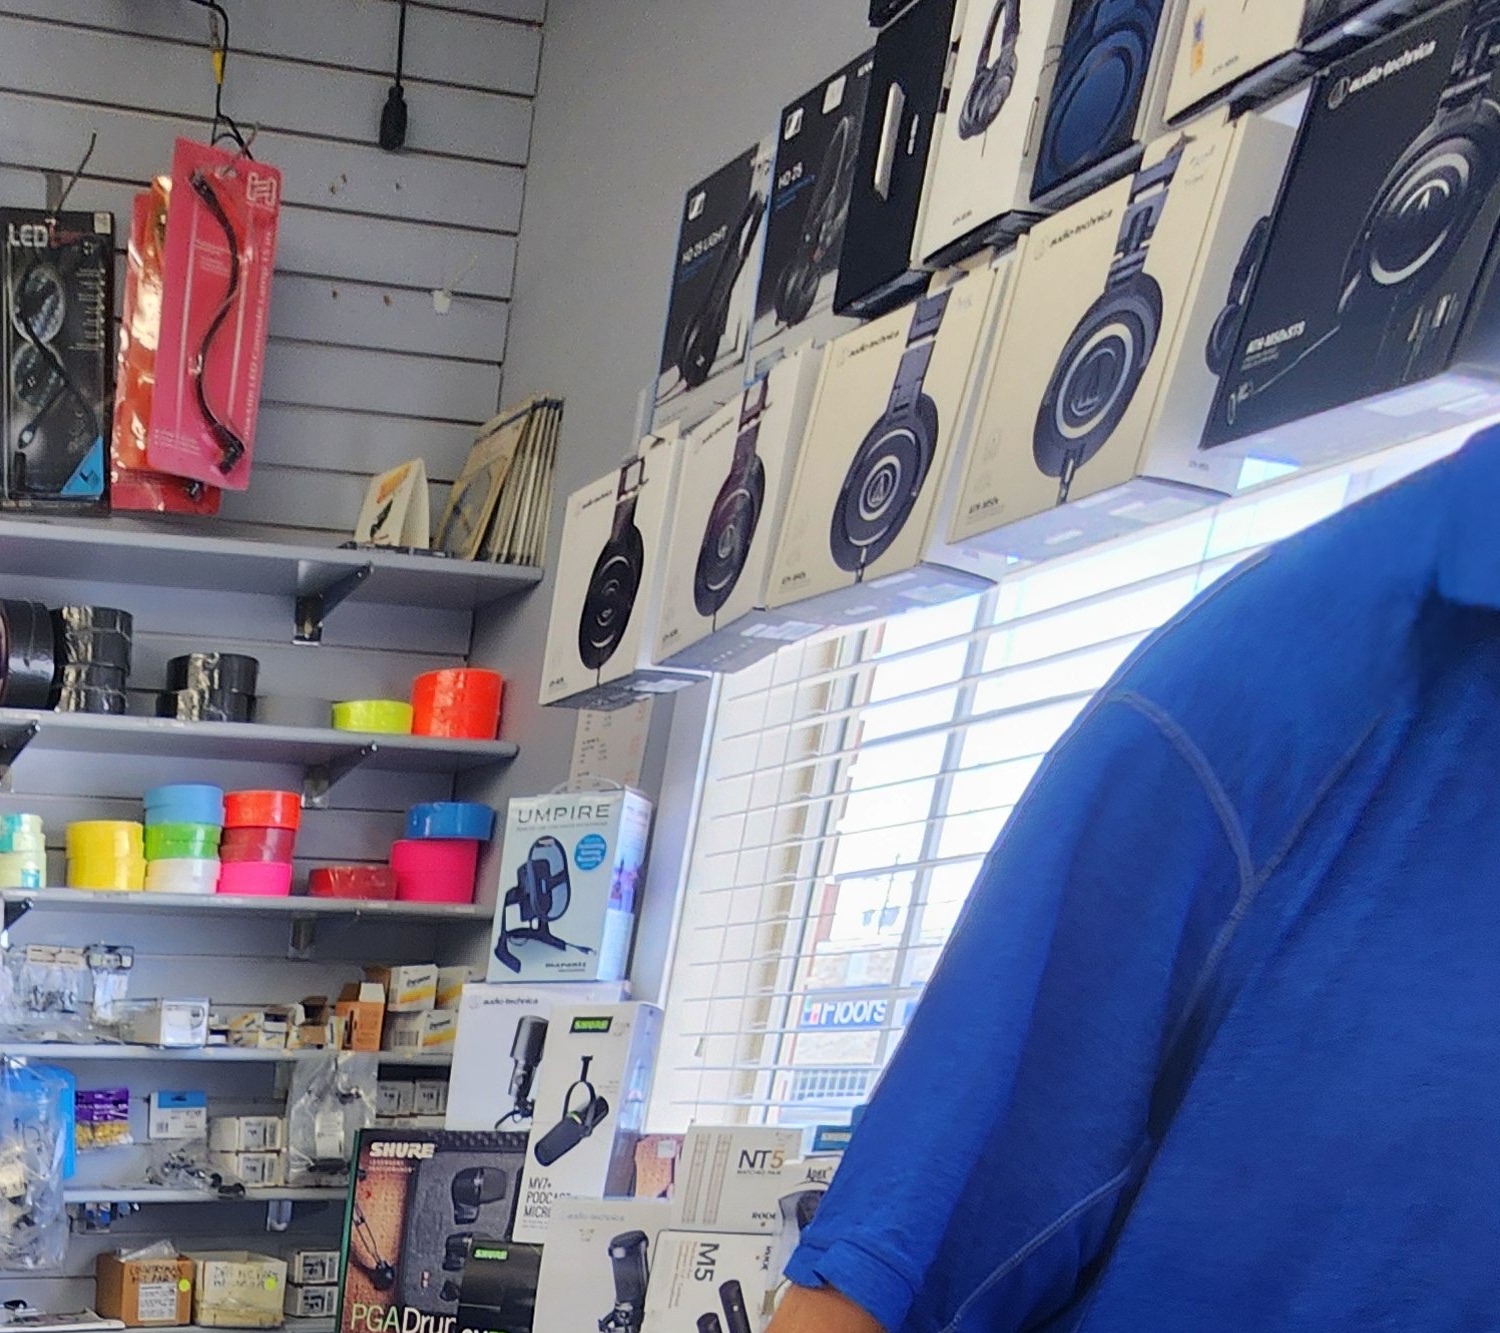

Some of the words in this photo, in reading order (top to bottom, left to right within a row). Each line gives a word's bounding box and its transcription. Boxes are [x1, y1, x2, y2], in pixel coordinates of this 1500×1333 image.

[8, 223, 48, 247] LED
[517, 803, 610, 825] UMPIRE
[369, 1142, 437, 1159] SHURE
[739, 1149, 784, 1169] NT5
[694, 1242, 720, 1283] M5
